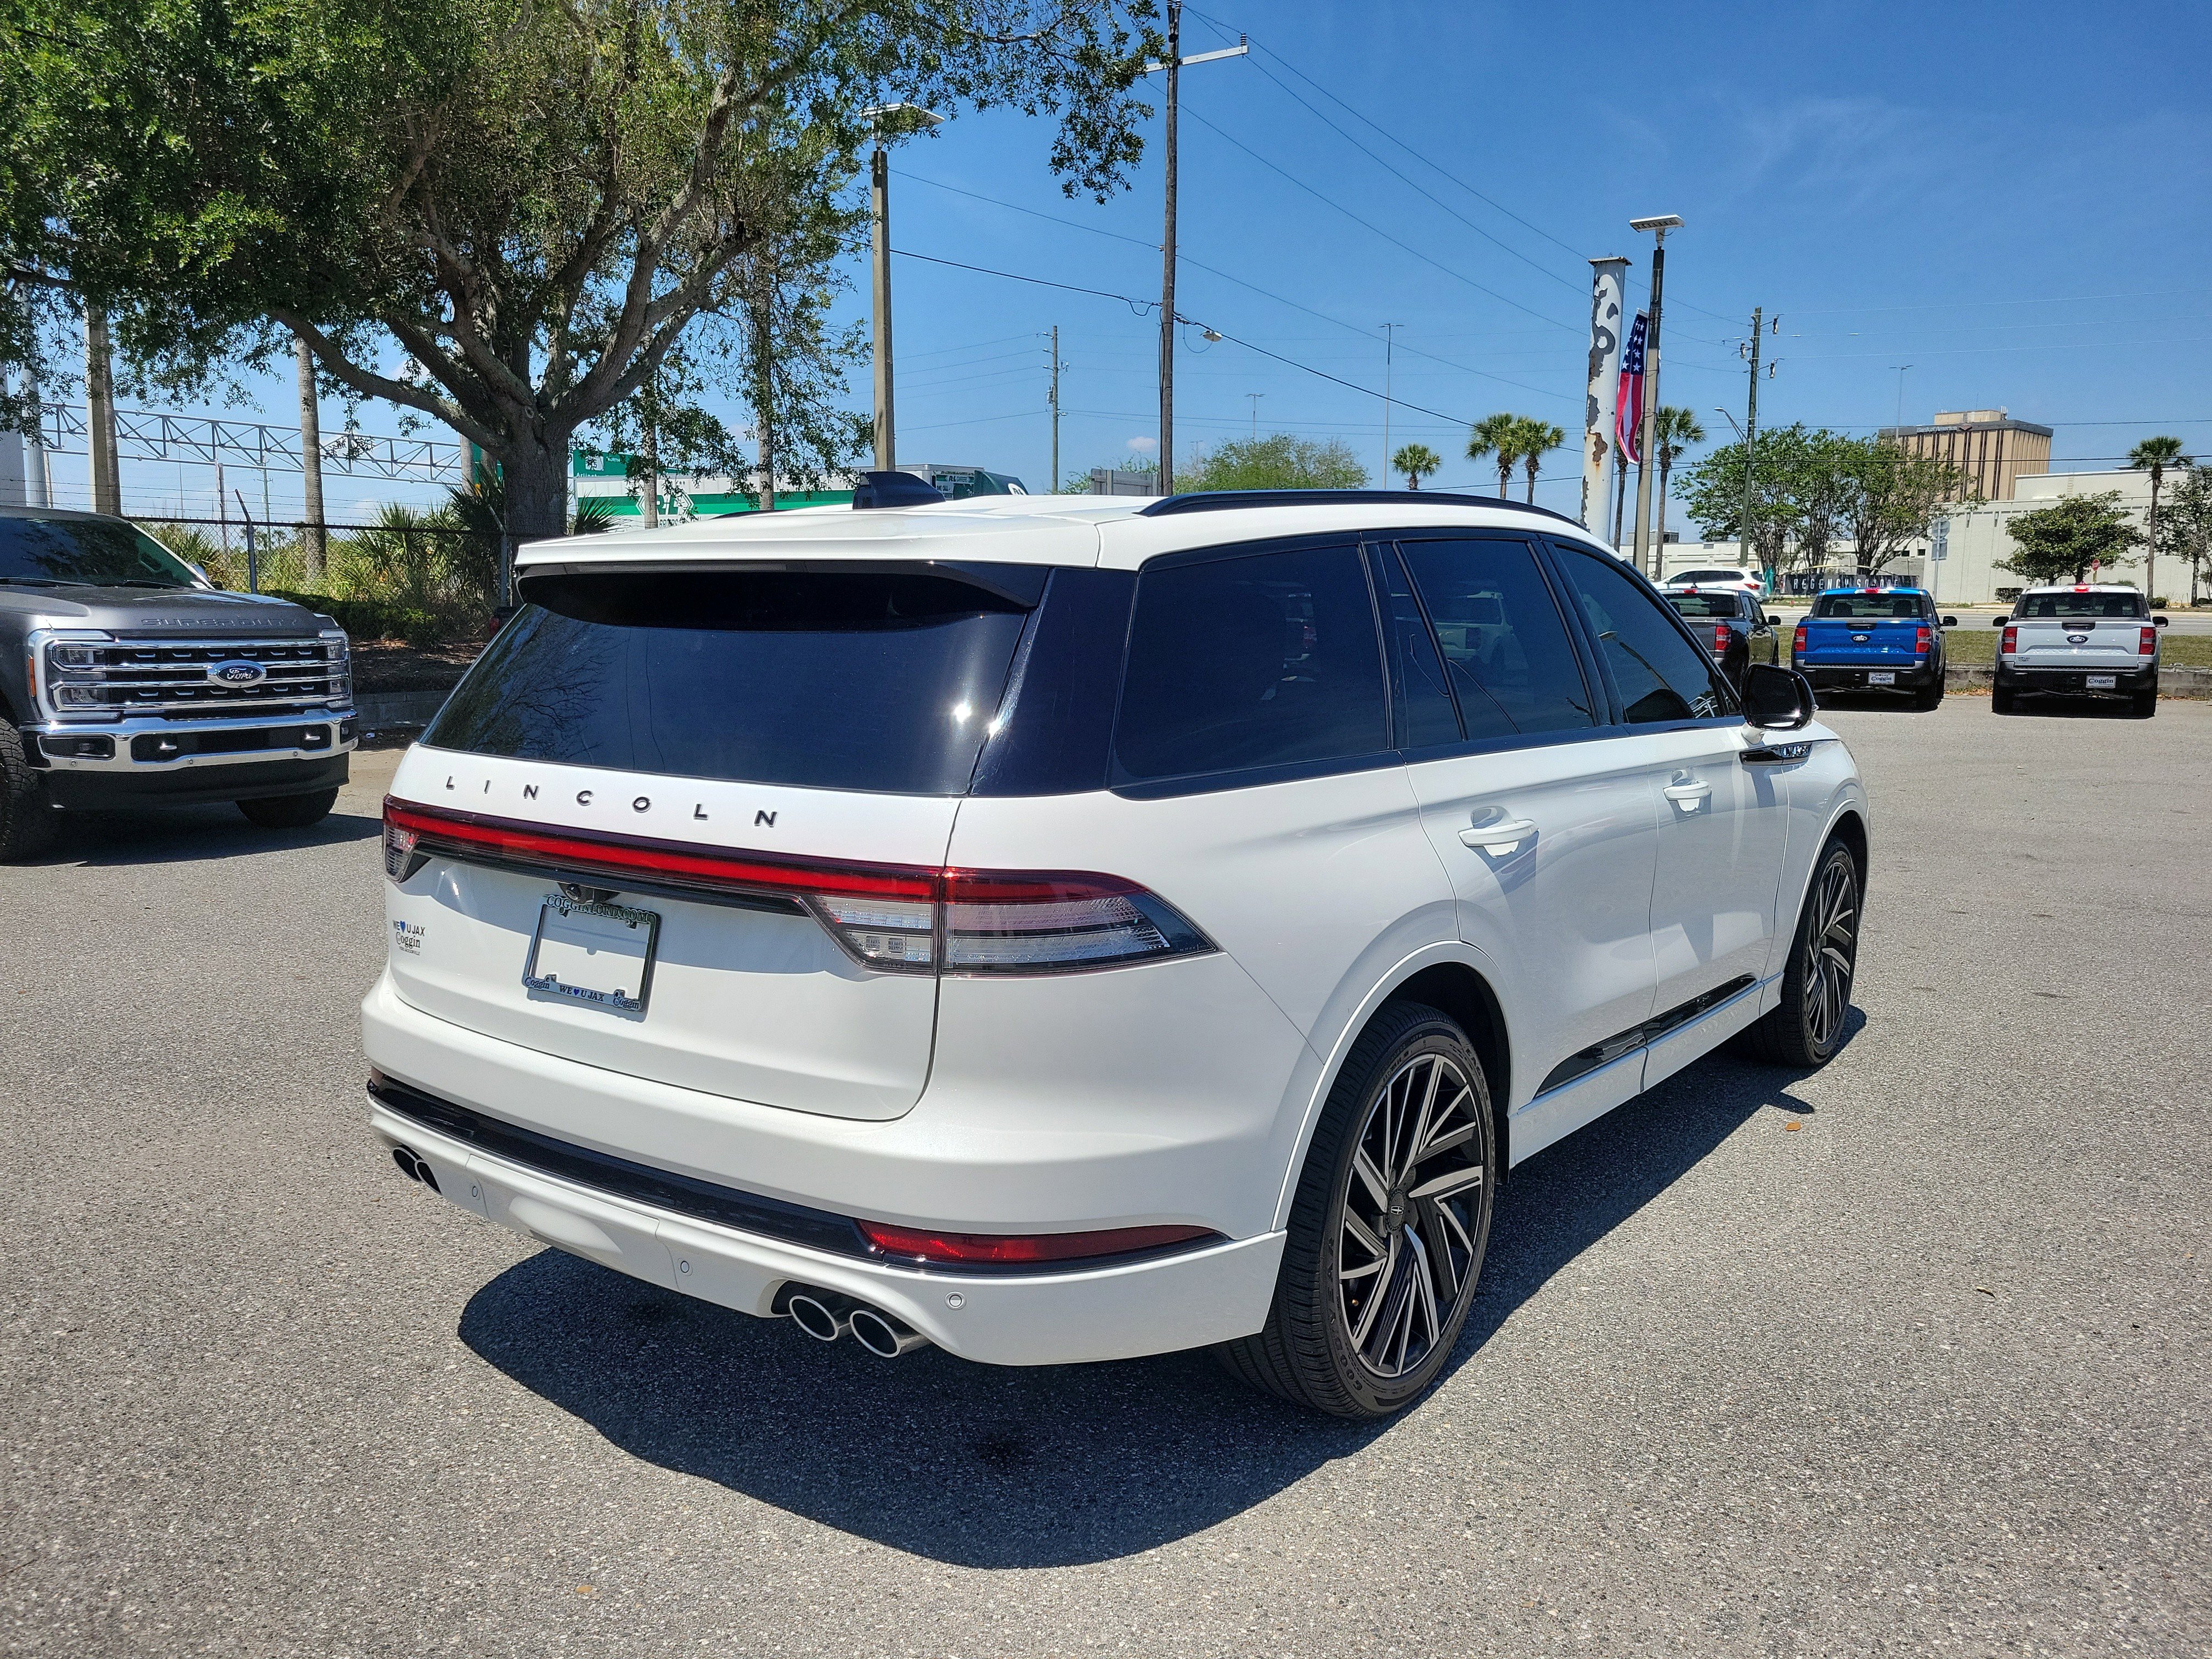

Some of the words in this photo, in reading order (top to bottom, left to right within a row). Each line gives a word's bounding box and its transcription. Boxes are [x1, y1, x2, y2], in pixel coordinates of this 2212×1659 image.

[1793, 578, 1849, 590] REGENCY
[141, 618, 235, 627] SUPER
[227, 668, 254, 680] Ford
[445, 775, 778, 828] LINCOLN
[407, 923, 411, 933] U
[412, 925, 425, 936] JAX
[396, 932, 420, 949] Coggin
[524, 977, 550, 990] Coggin
[559, 985, 572, 995] WE
[588, 991, 605, 1002] JAX
[613, 997, 640, 1010] Coggin
